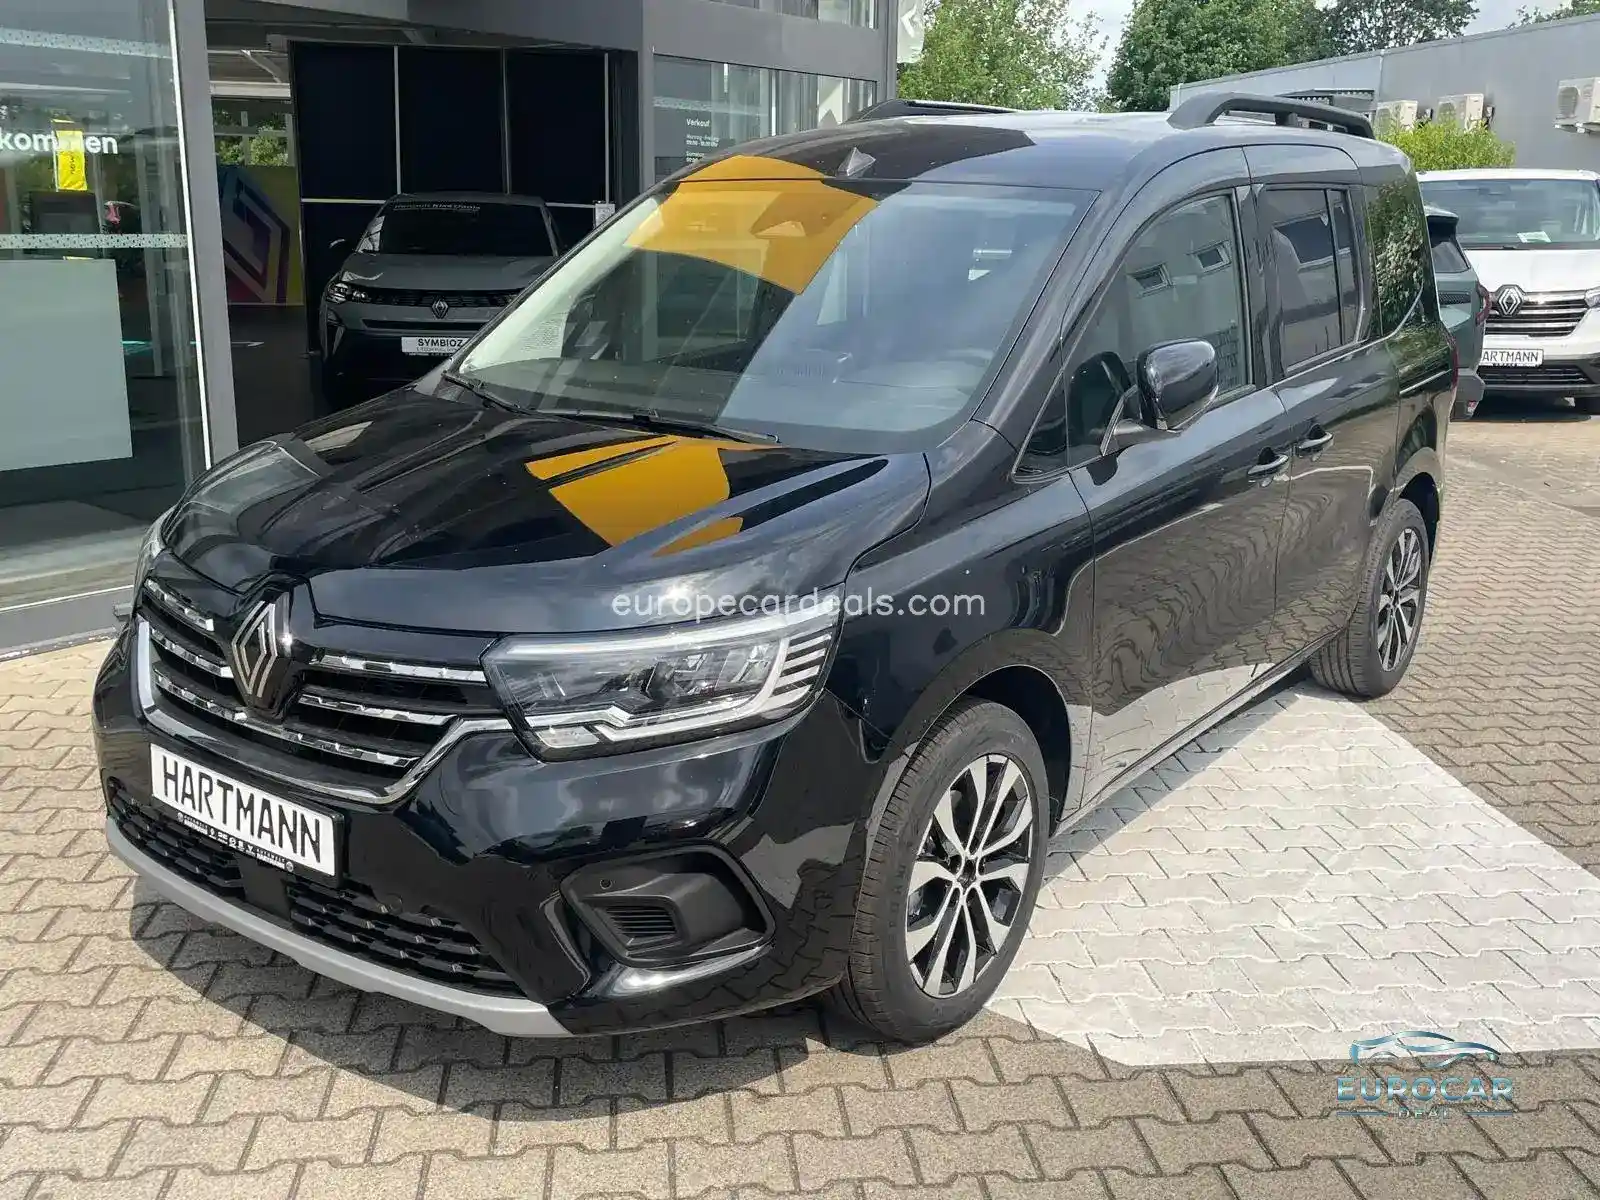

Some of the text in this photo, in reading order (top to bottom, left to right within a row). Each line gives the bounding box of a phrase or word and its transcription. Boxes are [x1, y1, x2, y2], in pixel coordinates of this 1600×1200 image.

[686, 118, 710, 127] Verkauf
[0, 127, 118, 154] komen
[417, 338, 464, 348] SYMBIOZ
[1482, 350, 1539, 362] ARTMANN
[162, 755, 321, 864] HARTMANN
